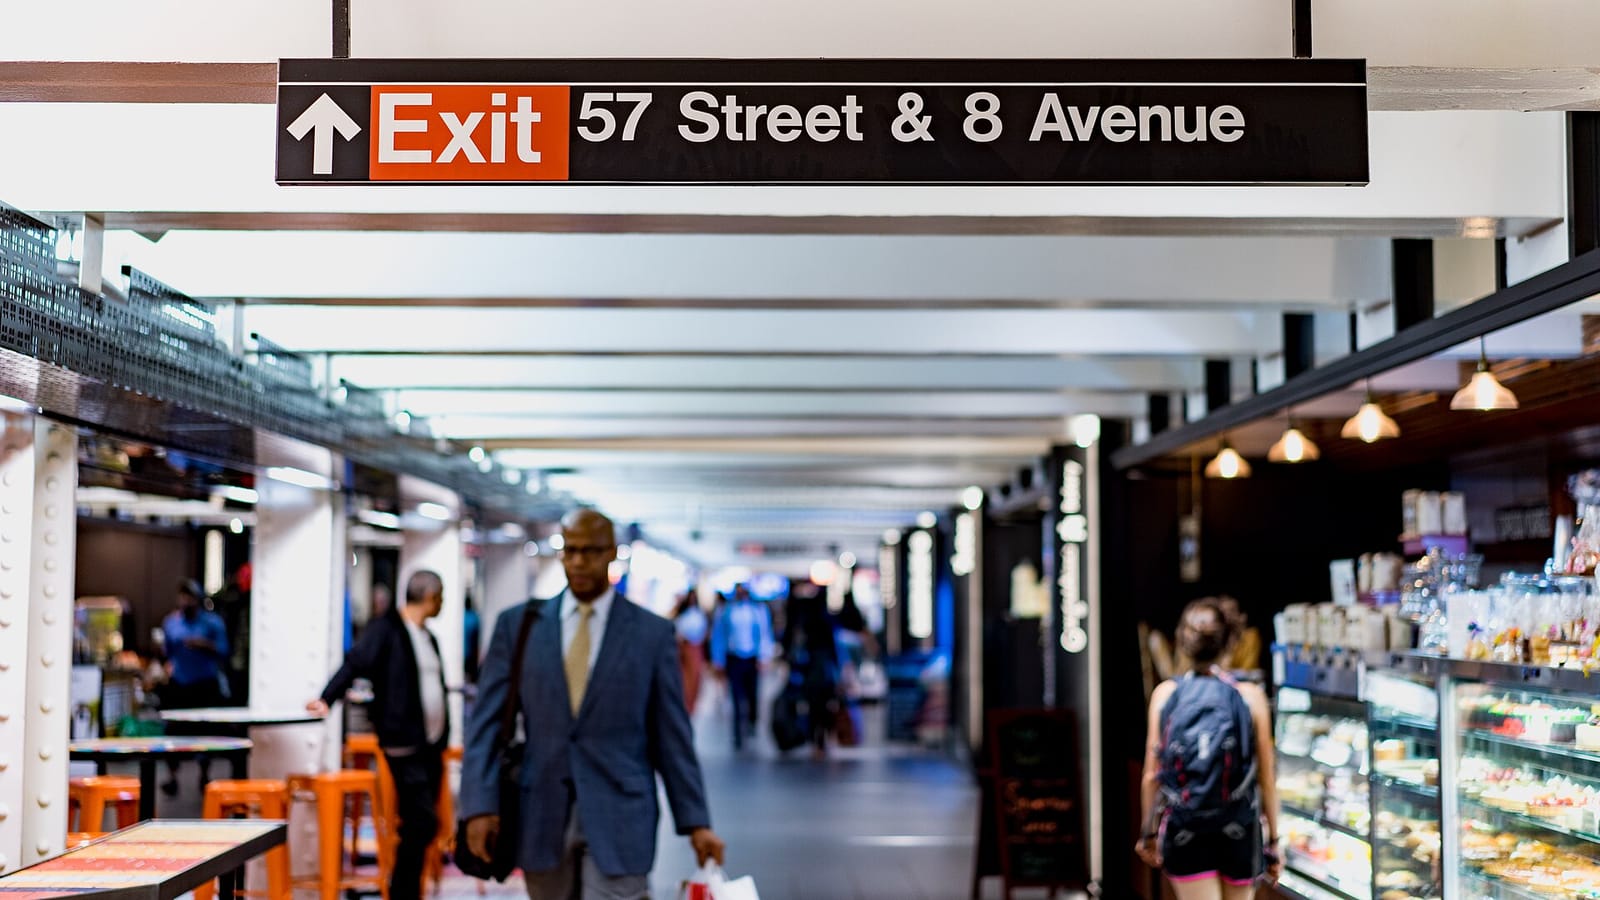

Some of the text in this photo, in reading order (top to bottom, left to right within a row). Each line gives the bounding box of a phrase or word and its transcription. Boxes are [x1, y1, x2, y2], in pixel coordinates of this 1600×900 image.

[379, 91, 1245, 163] Exit 57 Street & 8 Avenue
